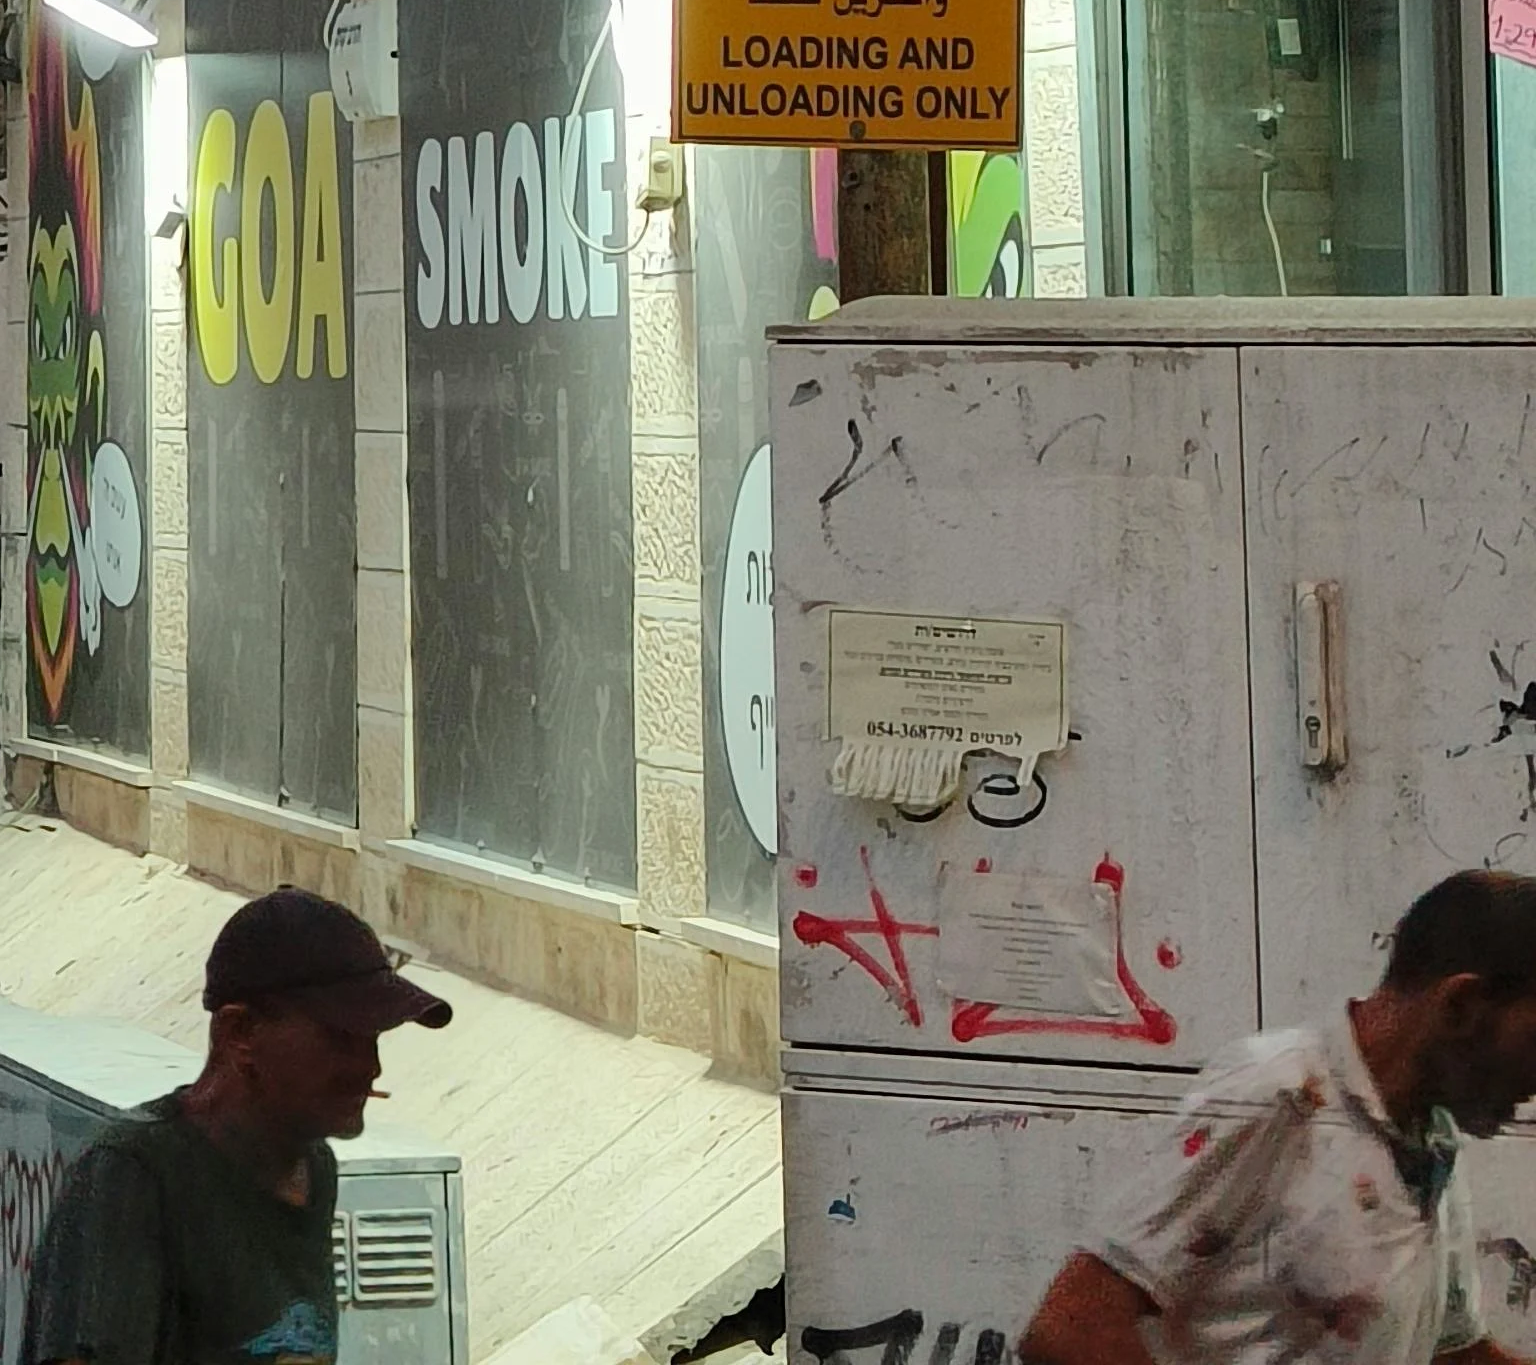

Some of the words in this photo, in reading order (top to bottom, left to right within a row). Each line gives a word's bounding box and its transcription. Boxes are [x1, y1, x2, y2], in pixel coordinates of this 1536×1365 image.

[721, 35, 889, 70] LOADING
[897, 36, 976, 71] AND
[685, 82, 904, 118] UNLOADING
[915, 85, 1011, 121] ONLY
[194, 91, 348, 385] GOA
[415, 108, 619, 330] SMOKE
[866, 720, 964, 743] 054-3687792
[969, 730, 1023, 747] לפרטים
